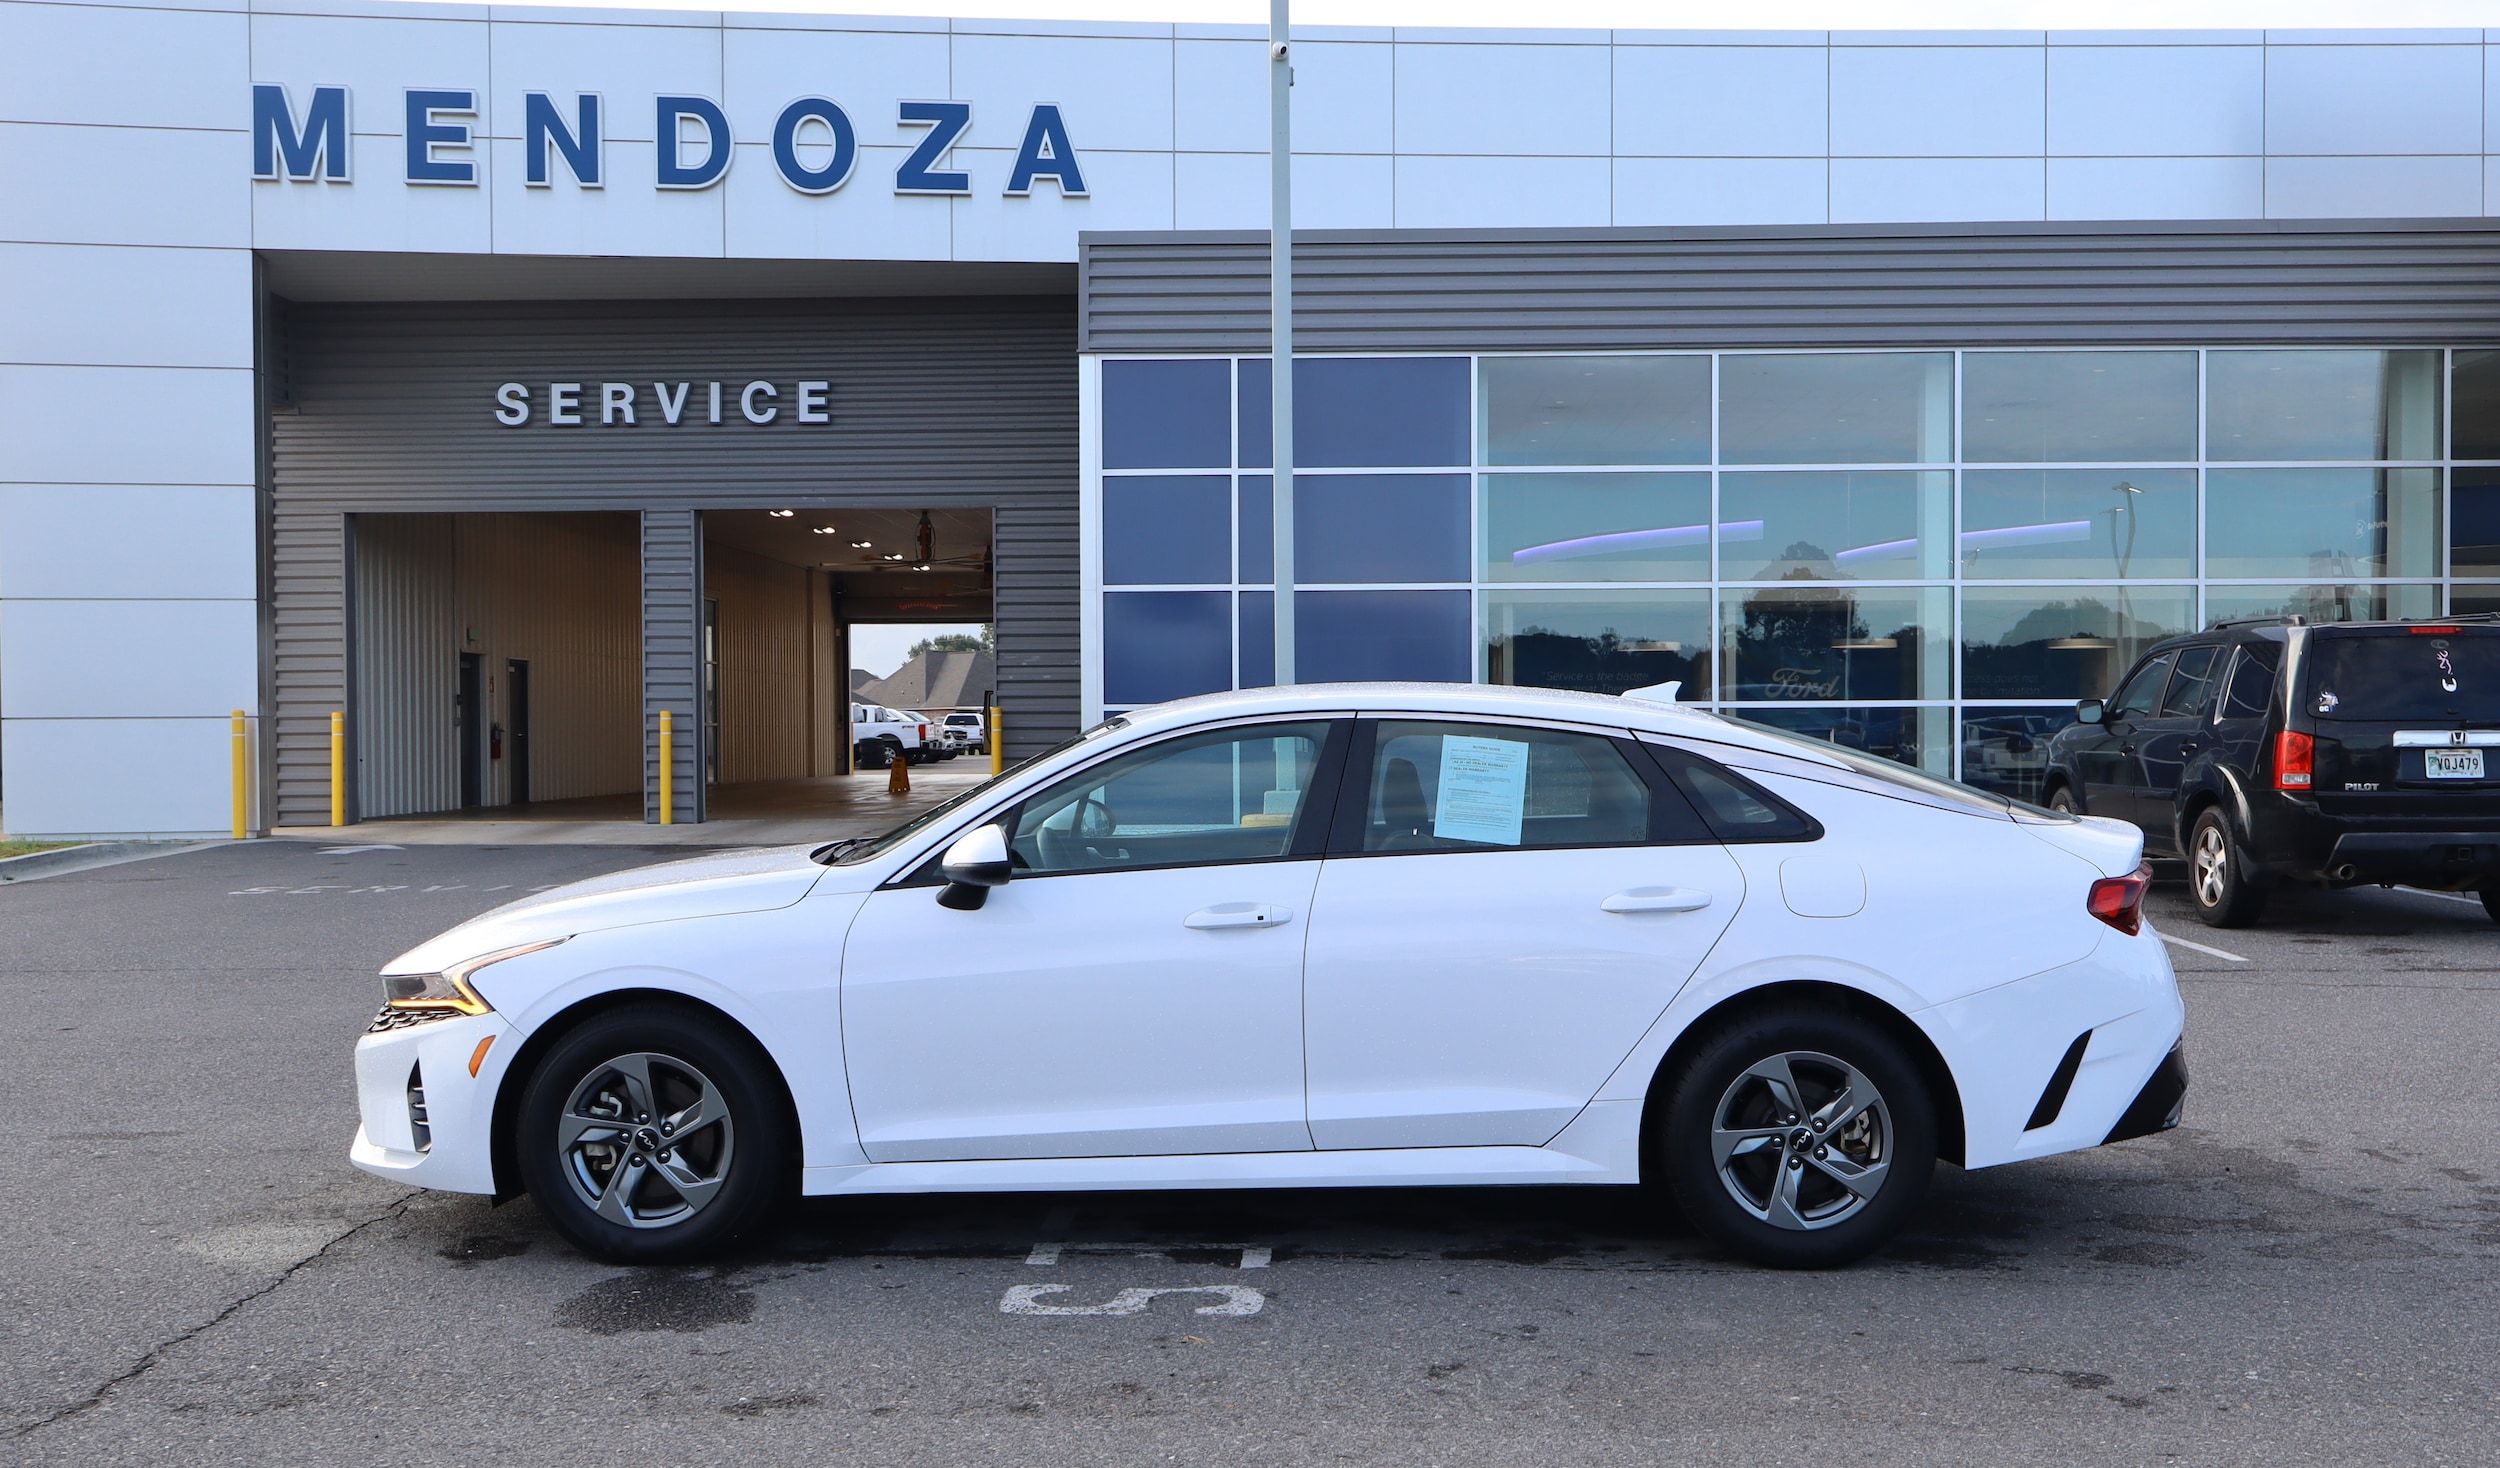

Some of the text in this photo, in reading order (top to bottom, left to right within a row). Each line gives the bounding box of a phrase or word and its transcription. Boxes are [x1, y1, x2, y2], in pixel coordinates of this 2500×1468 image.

[249, 82, 1090, 198] MENDOZA
[493, 379, 832, 427] SERVICE
[1597, 671, 1614, 681] the
[1616, 671, 1649, 683] badge
[1764, 667, 1841, 698] Ford
[2344, 783, 2380, 791] PILOT
